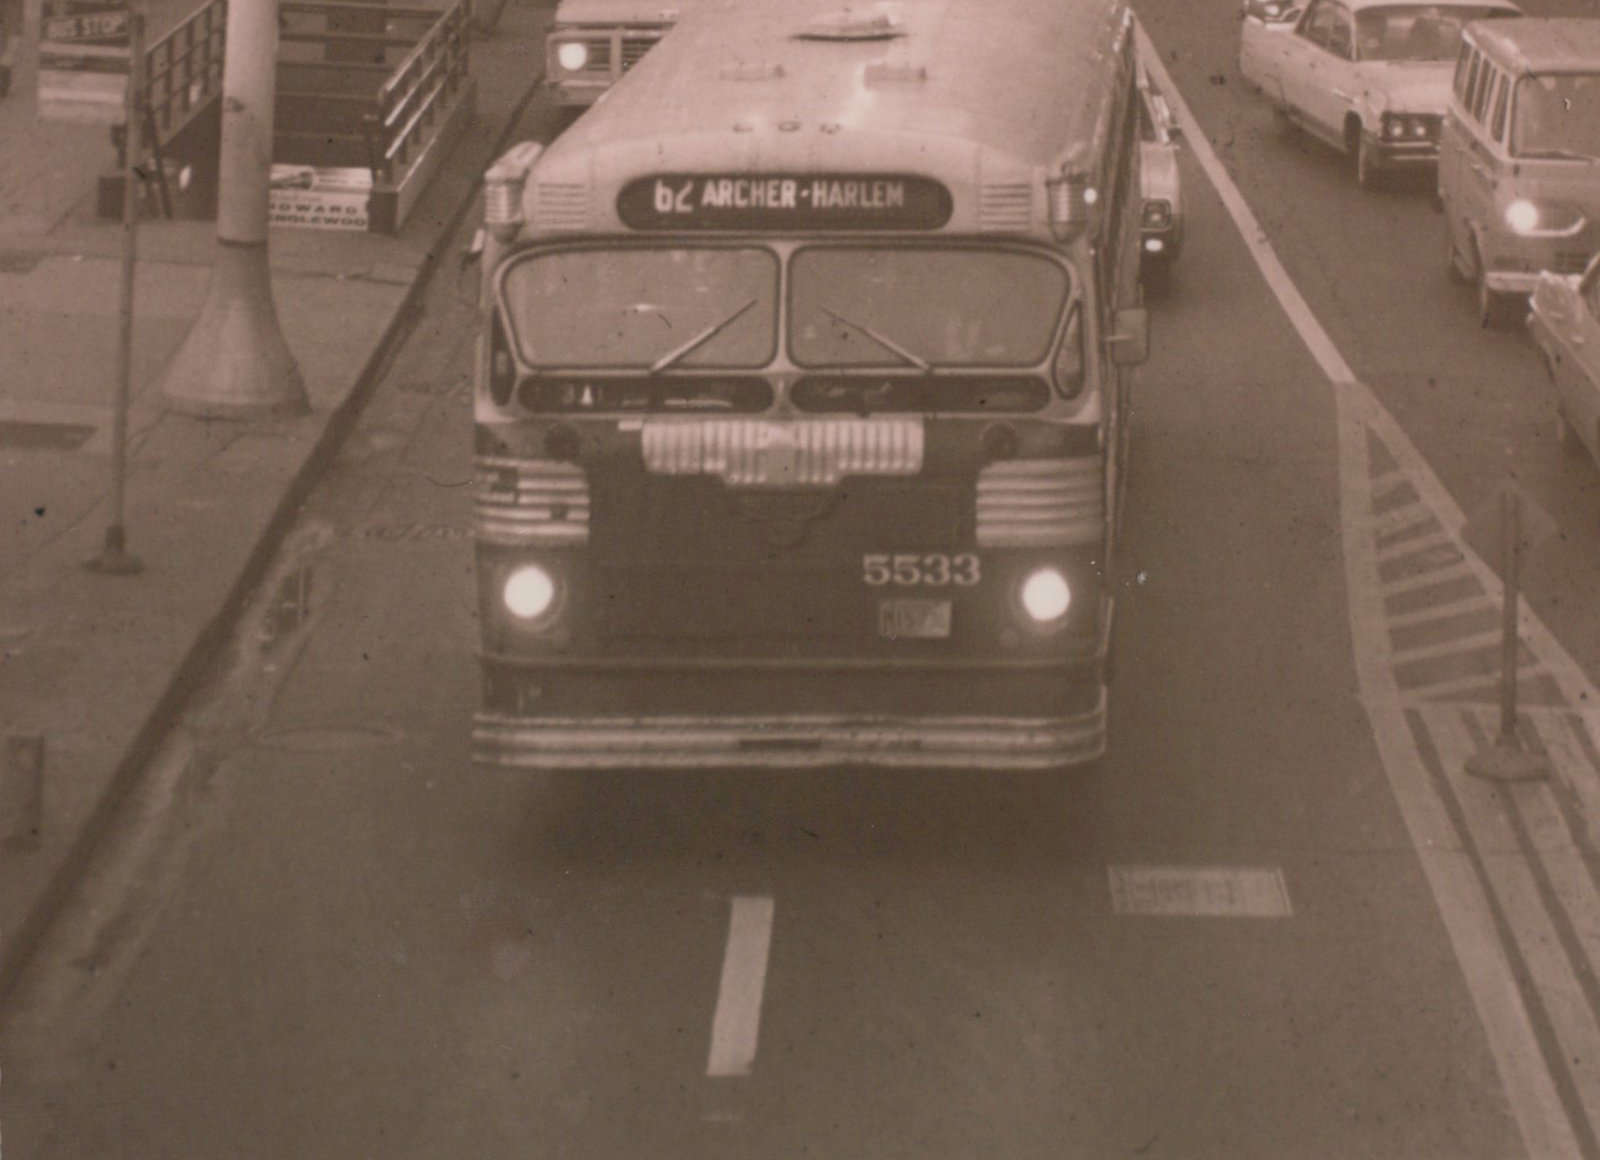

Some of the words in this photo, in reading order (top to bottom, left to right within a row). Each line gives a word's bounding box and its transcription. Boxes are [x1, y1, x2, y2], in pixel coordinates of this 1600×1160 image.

[81, 14, 124, 36] STOP
[653, 179, 694, 213] 62
[862, 553, 982, 587] 5533
